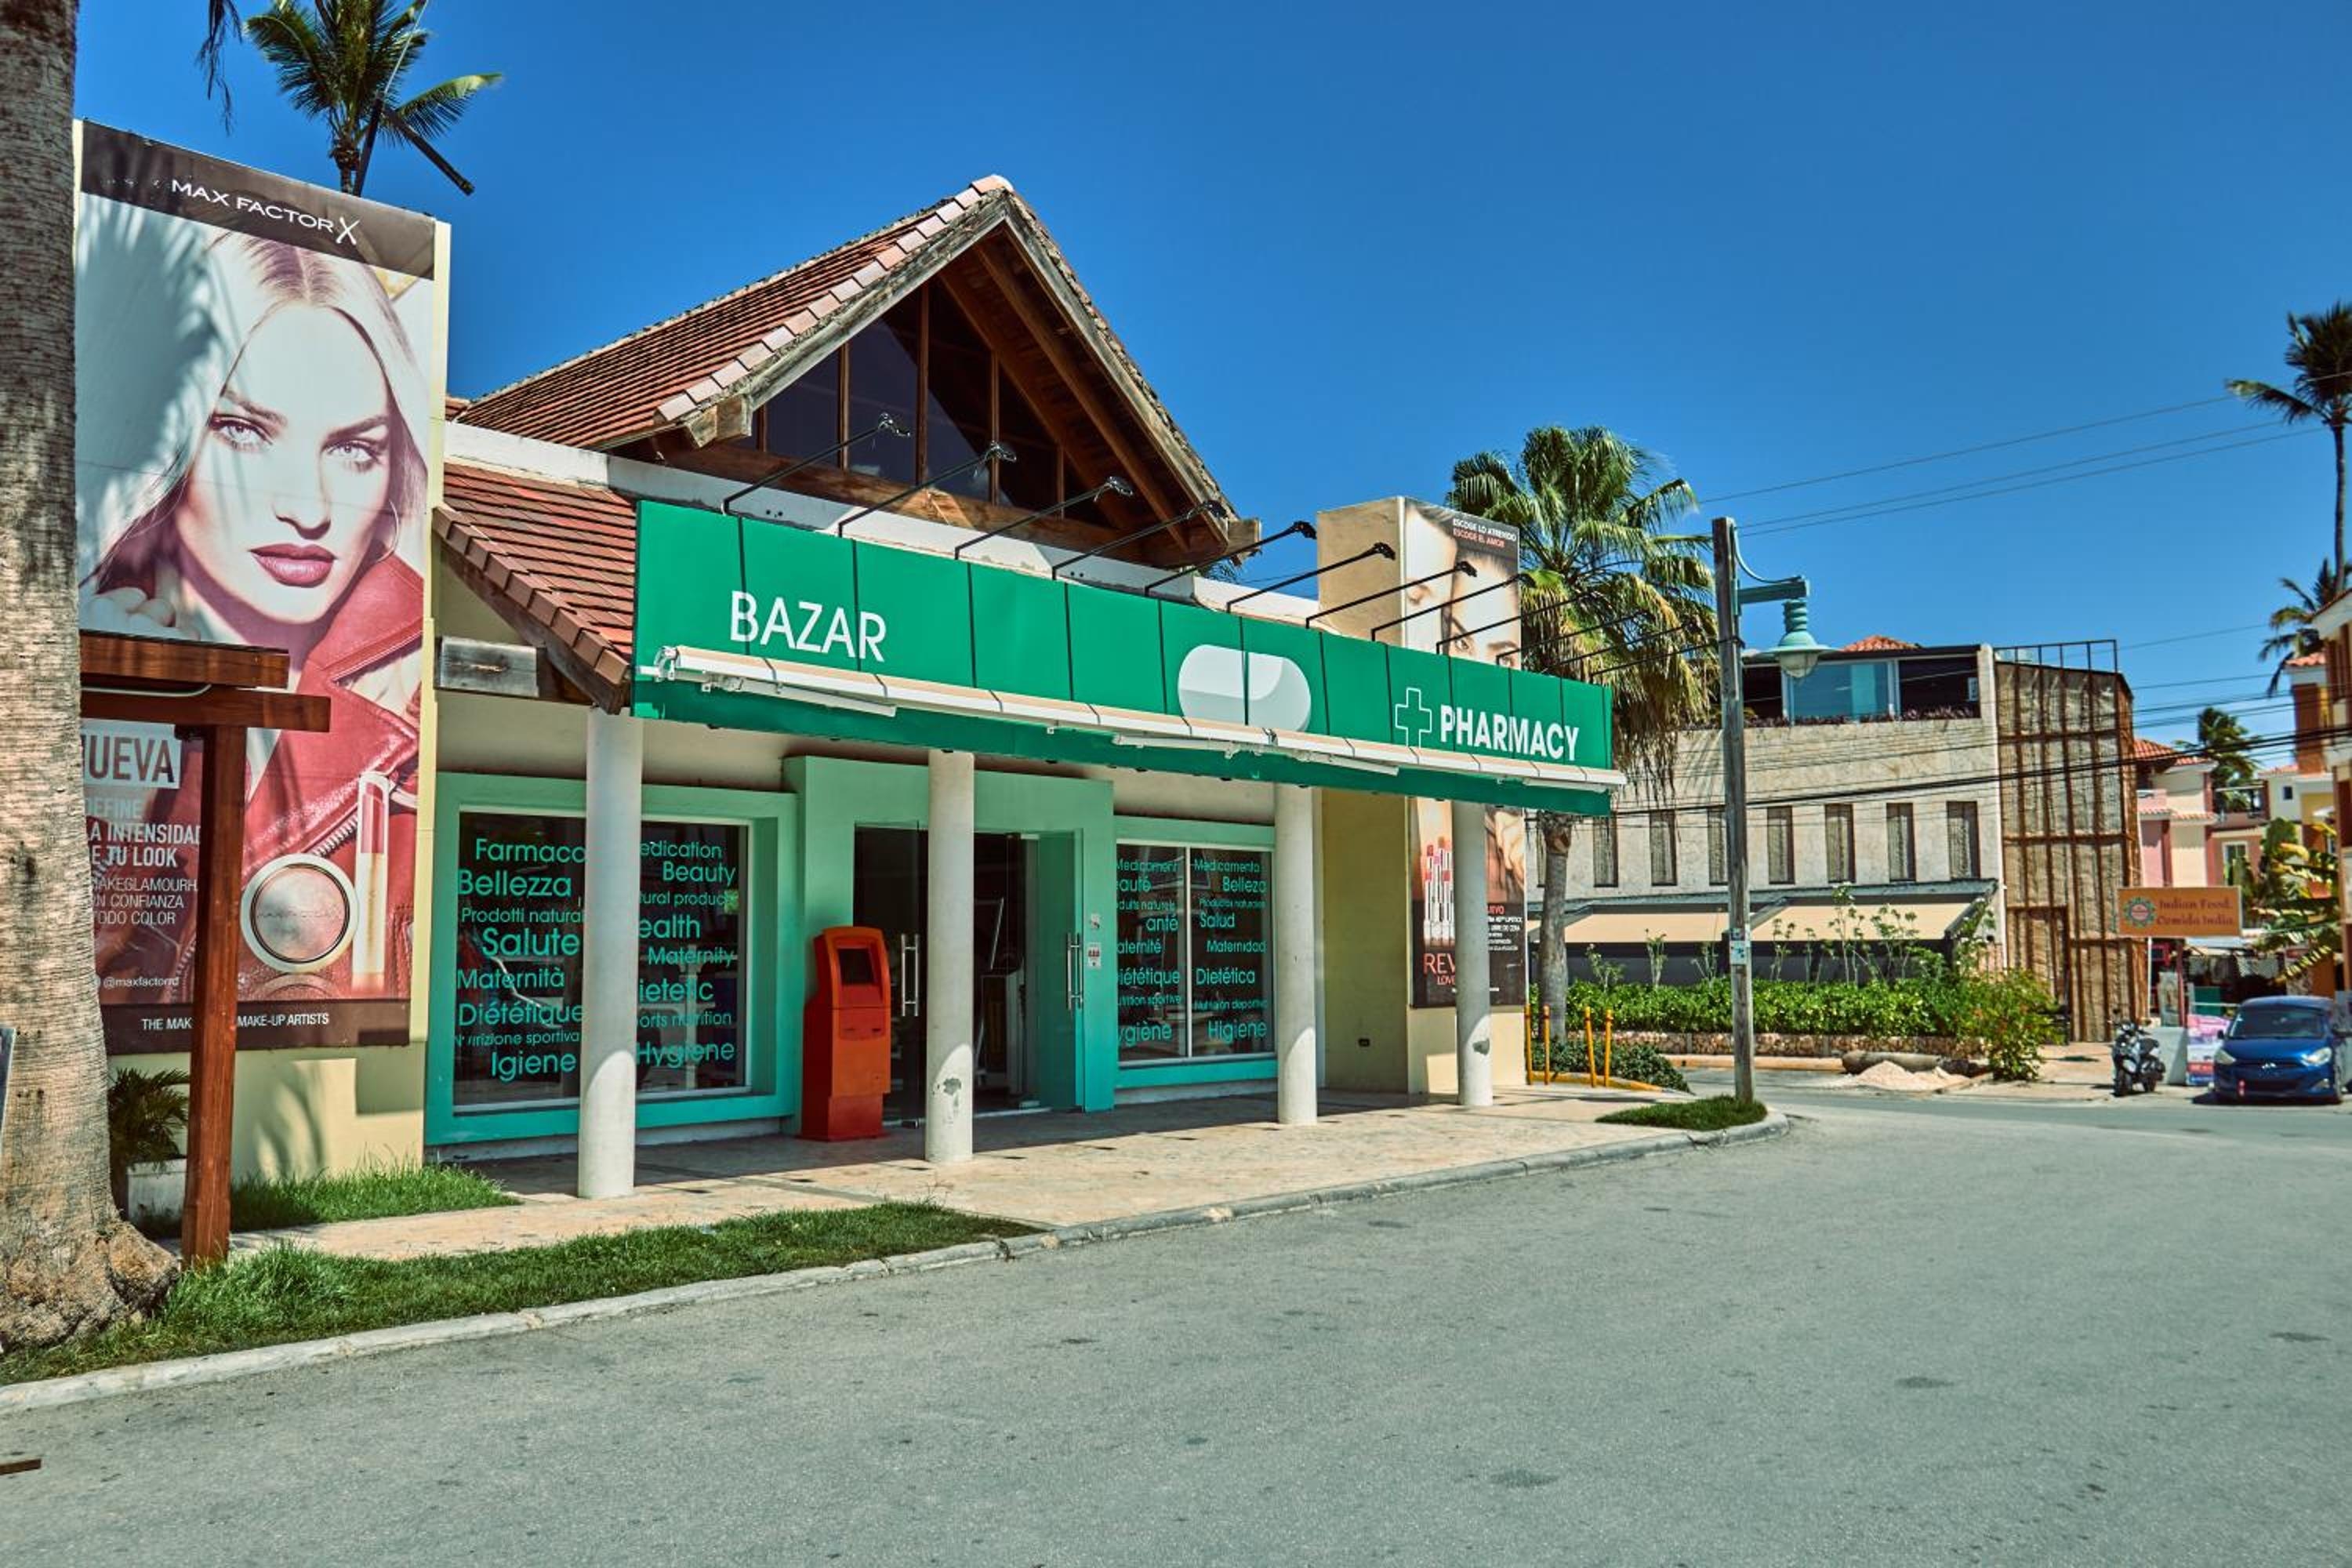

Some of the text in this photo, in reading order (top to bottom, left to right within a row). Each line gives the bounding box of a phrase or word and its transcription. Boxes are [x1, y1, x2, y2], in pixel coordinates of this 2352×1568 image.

[172, 179, 230, 207] MAX
[237, 198, 334, 233] FACTOR
[730, 590, 887, 662] BAZAR
[1440, 704, 1579, 761] PHARMACY
[89, 821, 101, 841] A
[92, 845, 178, 867] E TU LOOK
[640, 840, 722, 858] edication
[457, 869, 572, 896] Bellezza
[662, 861, 735, 886] Beauty
[111, 894, 184, 909] CONFIANZA
[131, 911, 176, 924] COLOR
[462, 907, 524, 923] Prodotti
[639, 913, 700, 938] ealth
[1200, 911, 1235, 928] Salud
[482, 927, 580, 957] Salute
[1117, 938, 1162, 954] aternité
[1207, 940, 1267, 953] Maternidad
[648, 946, 735, 967] Maternity
[457, 967, 564, 989] Maternità
[1118, 967, 1180, 988] iététique
[1196, 967, 1255, 985] Dietética
[639, 978, 714, 1002] ietetic
[141, 1018, 163, 1030] THE
[238, 1014, 285, 1027] MAKE-UP
[287, 1013, 329, 1026] ARTISTS
[638, 1011, 666, 1028] orts
[526, 1029, 580, 1046] sportiva
[1119, 1020, 1172, 1047] ygiène
[1208, 1019, 1267, 1044] Higiene
[637, 1041, 735, 1068] Hygiene
[492, 1050, 576, 1081] Igiene
